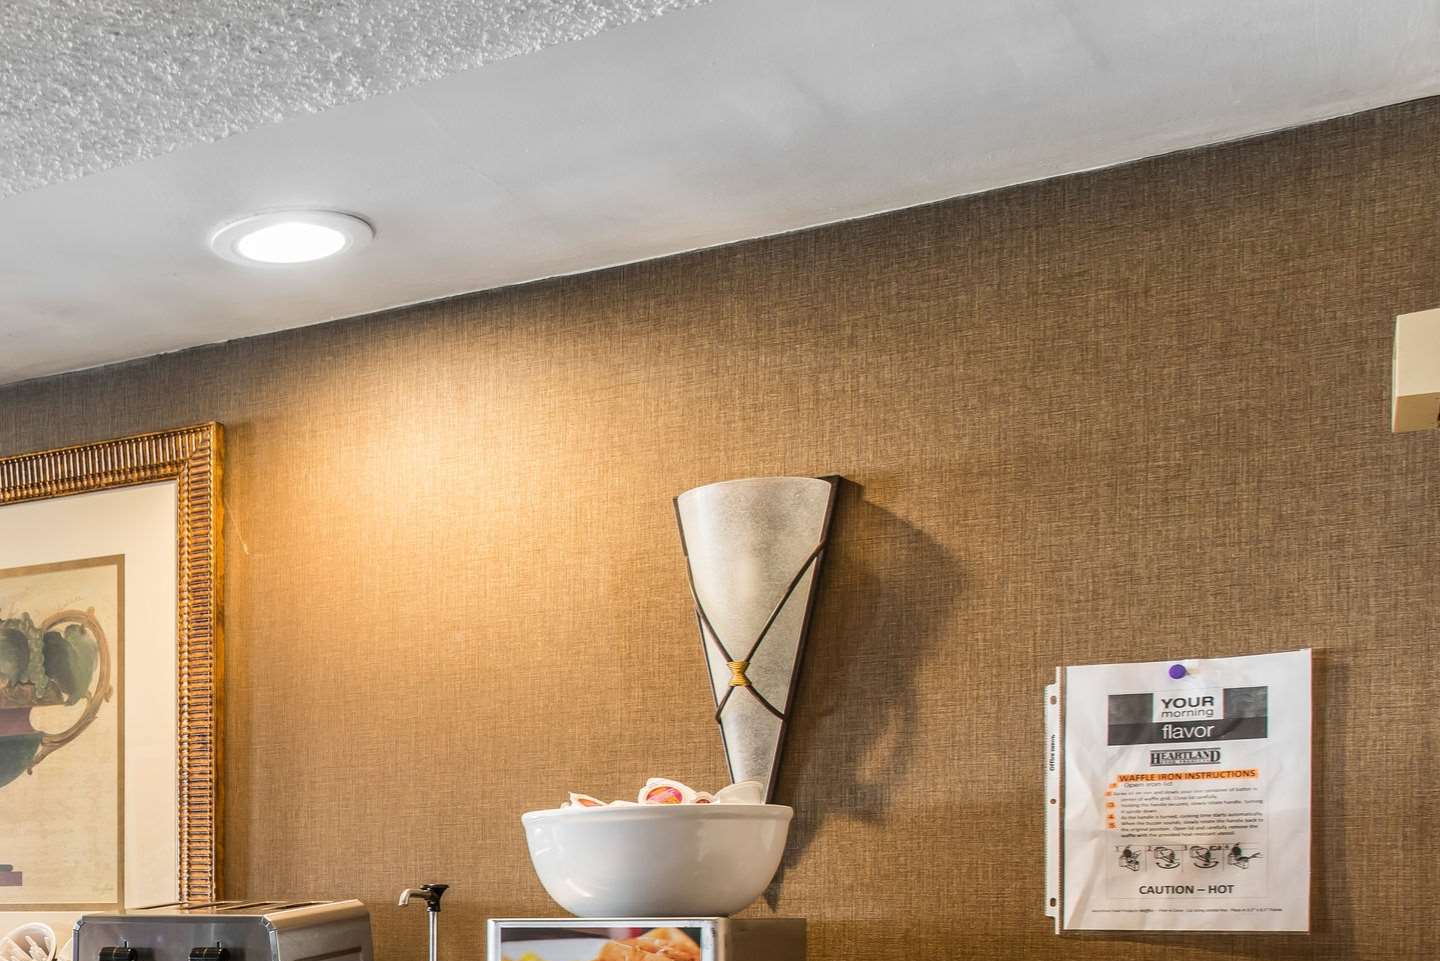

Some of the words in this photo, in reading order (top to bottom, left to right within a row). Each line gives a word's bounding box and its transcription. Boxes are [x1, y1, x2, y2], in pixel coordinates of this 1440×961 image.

[1161, 696, 1215, 708] YOUR
[1161, 708, 1215, 718] morning
[1161, 724, 1215, 740] flavor
[1151, 750, 1221, 764] HEARTLAND
[1119, 773, 1155, 782] WAFFLE
[1158, 772, 1182, 781] IRON
[1185, 769, 1256, 780] INSTRUCTIONS
[1139, 885, 1195, 895] CAUTION
[1208, 884, 1235, 894] HOT
